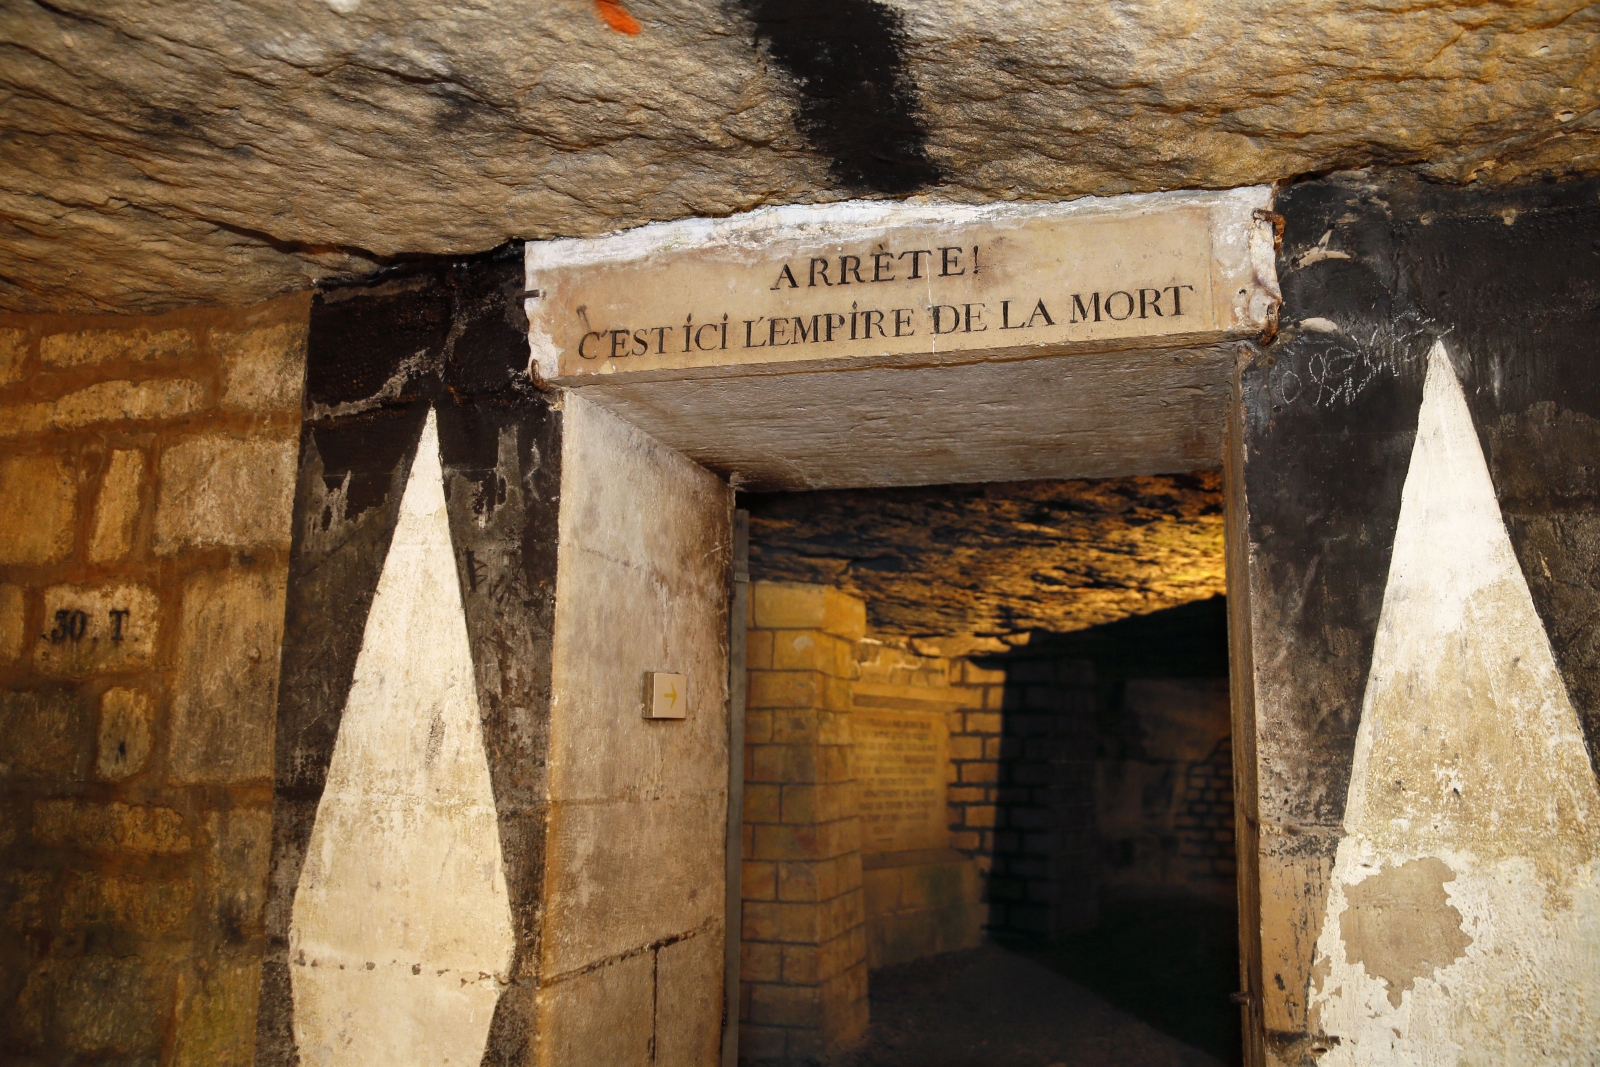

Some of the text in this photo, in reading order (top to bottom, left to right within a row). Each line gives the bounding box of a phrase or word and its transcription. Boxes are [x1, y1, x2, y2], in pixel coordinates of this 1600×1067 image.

[577, 326, 673, 360] C'EST
[927, 302, 988, 335] DE
[998, 297, 1056, 330] LA
[1069, 284, 1194, 324] MORT
